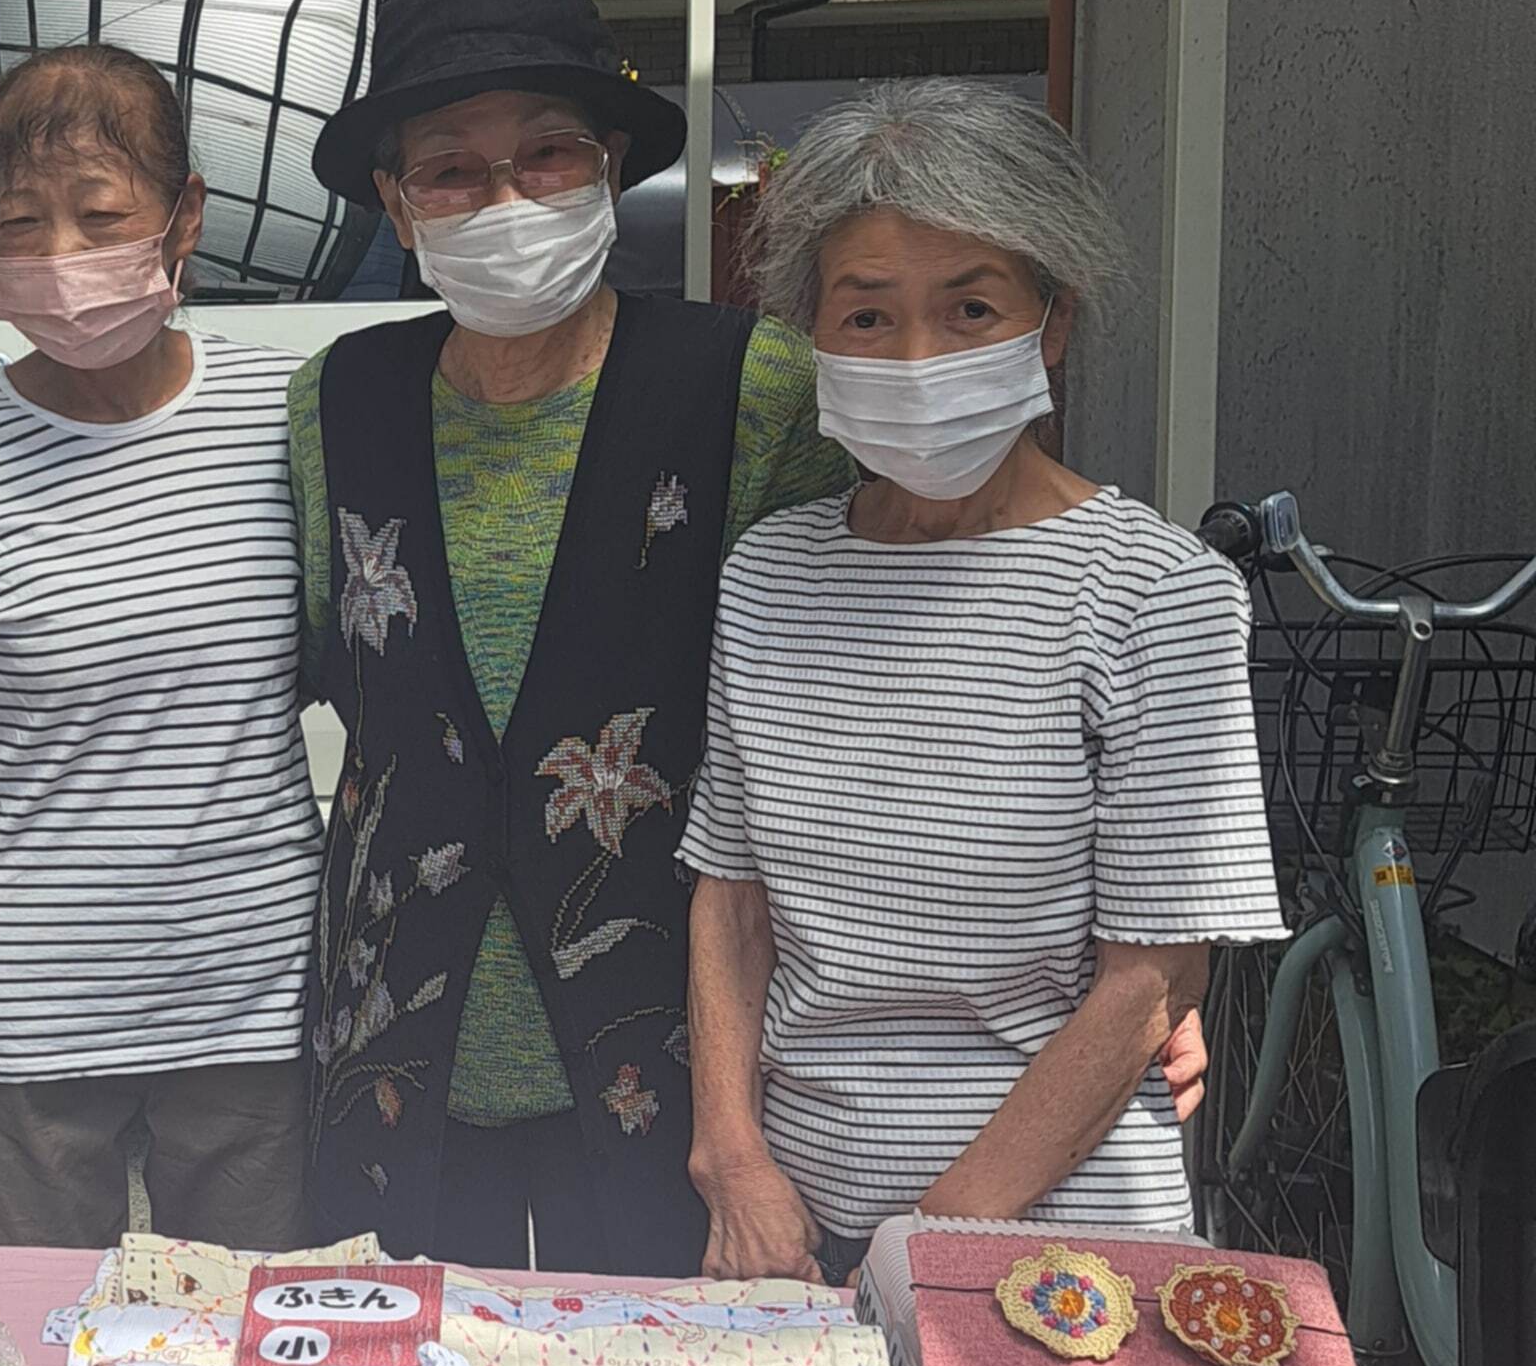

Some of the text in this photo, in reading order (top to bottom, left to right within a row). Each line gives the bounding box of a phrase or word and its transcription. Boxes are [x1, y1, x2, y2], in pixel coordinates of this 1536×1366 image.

[274, 1285, 398, 1310] ふきん
[274, 1336, 319, 1361] 小
